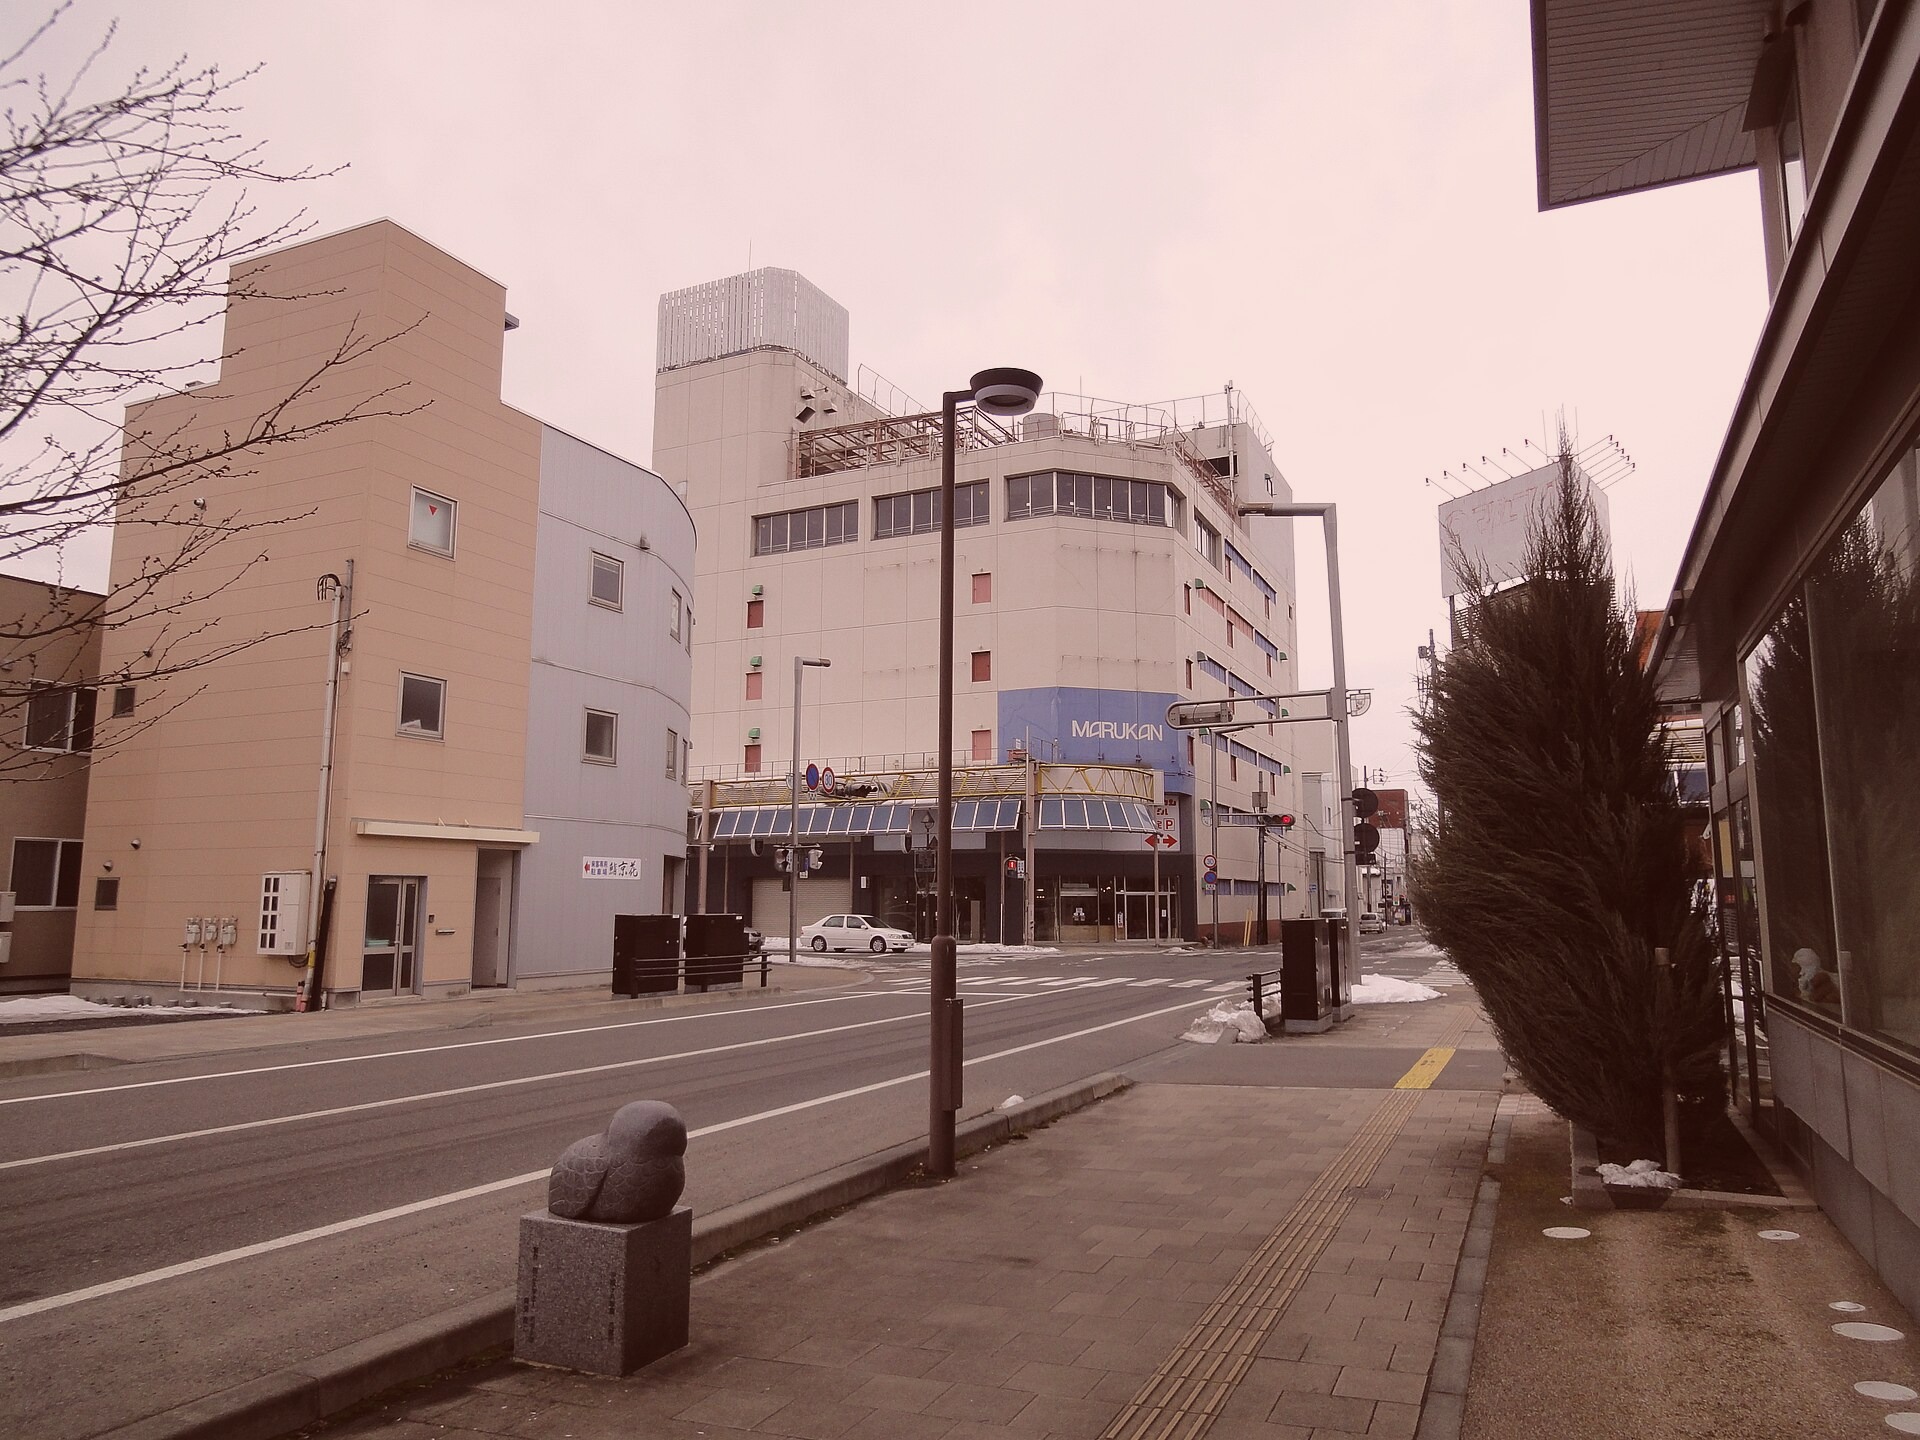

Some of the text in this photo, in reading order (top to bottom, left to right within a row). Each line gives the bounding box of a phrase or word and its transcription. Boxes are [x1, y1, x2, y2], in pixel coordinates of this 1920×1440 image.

[1071, 719, 1163, 741] MARUKAN
[825, 773, 833, 786] 30
[1165, 819, 1174, 830] P
